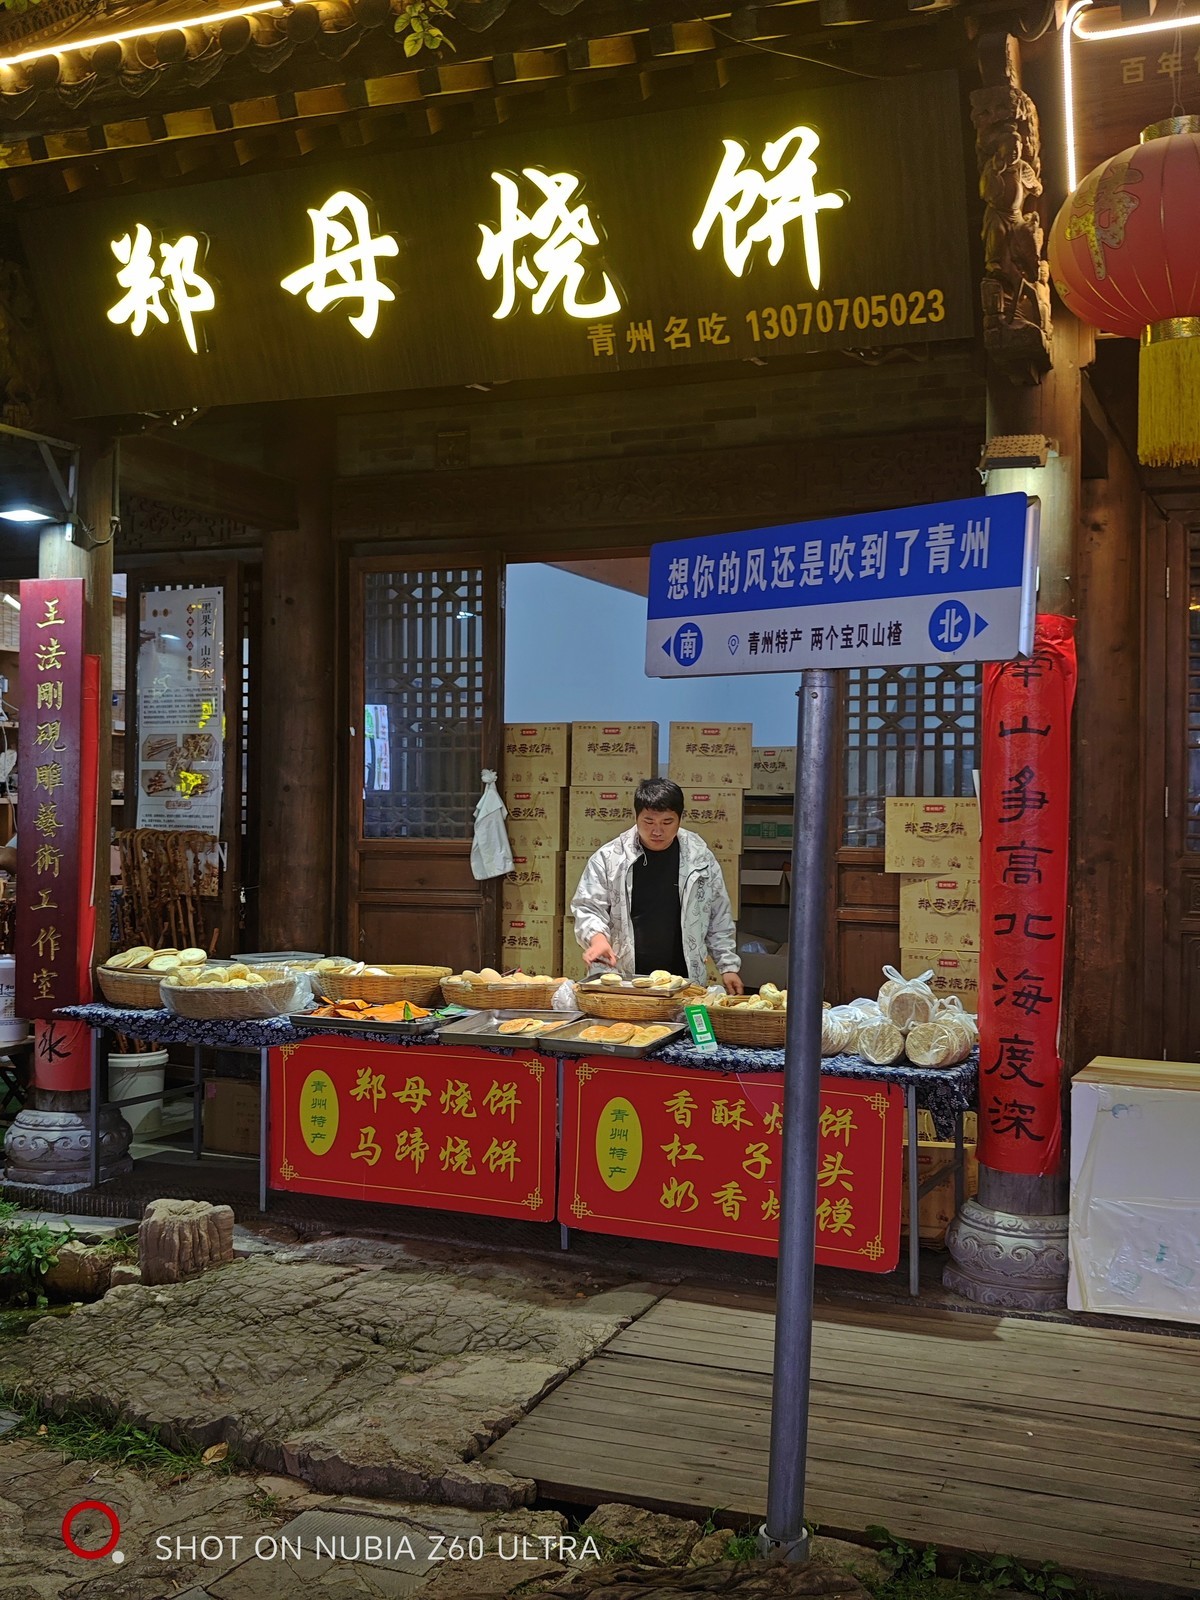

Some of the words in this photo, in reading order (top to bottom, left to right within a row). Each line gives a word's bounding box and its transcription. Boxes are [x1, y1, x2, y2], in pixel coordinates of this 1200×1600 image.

[1120, 47, 1200, 84] 百年
[107, 125, 845, 354] 郑母烧饼
[587, 312, 732, 358] 青州名吃
[745, 288, 946, 342] 13070705023
[667, 517, 991, 600] 想你的风还是吹到了青州
[200, 602, 212, 638] 黑果木
[747, 629, 803, 655] 青州特产
[810, 620, 903, 652] 两个宝贝山楂
[938, 607, 963, 644] 北
[678, 630, 697, 660] 南
[506, 743, 552, 754] 郑母烧饼
[587, 742, 636, 753] 郑母烧饼
[685, 743, 736, 754] 郑母烧饼
[509, 807, 546, 818] 母烧饼
[584, 808, 633, 819] 郑母烧饼
[905, 822, 964, 834] 郑母烧饼
[503, 872, 541, 882] 母烧饼
[918, 898, 976, 911] 郑母烧饼
[927, 976, 978, 992] 母烧饼
[310, 1080, 328, 1144] 青州特产
[349, 1066, 522, 1125] 郑母烧饼
[350, 1125, 522, 1183] 马蹄烧饼
[608, 1108, 629, 1179] 青州特产
